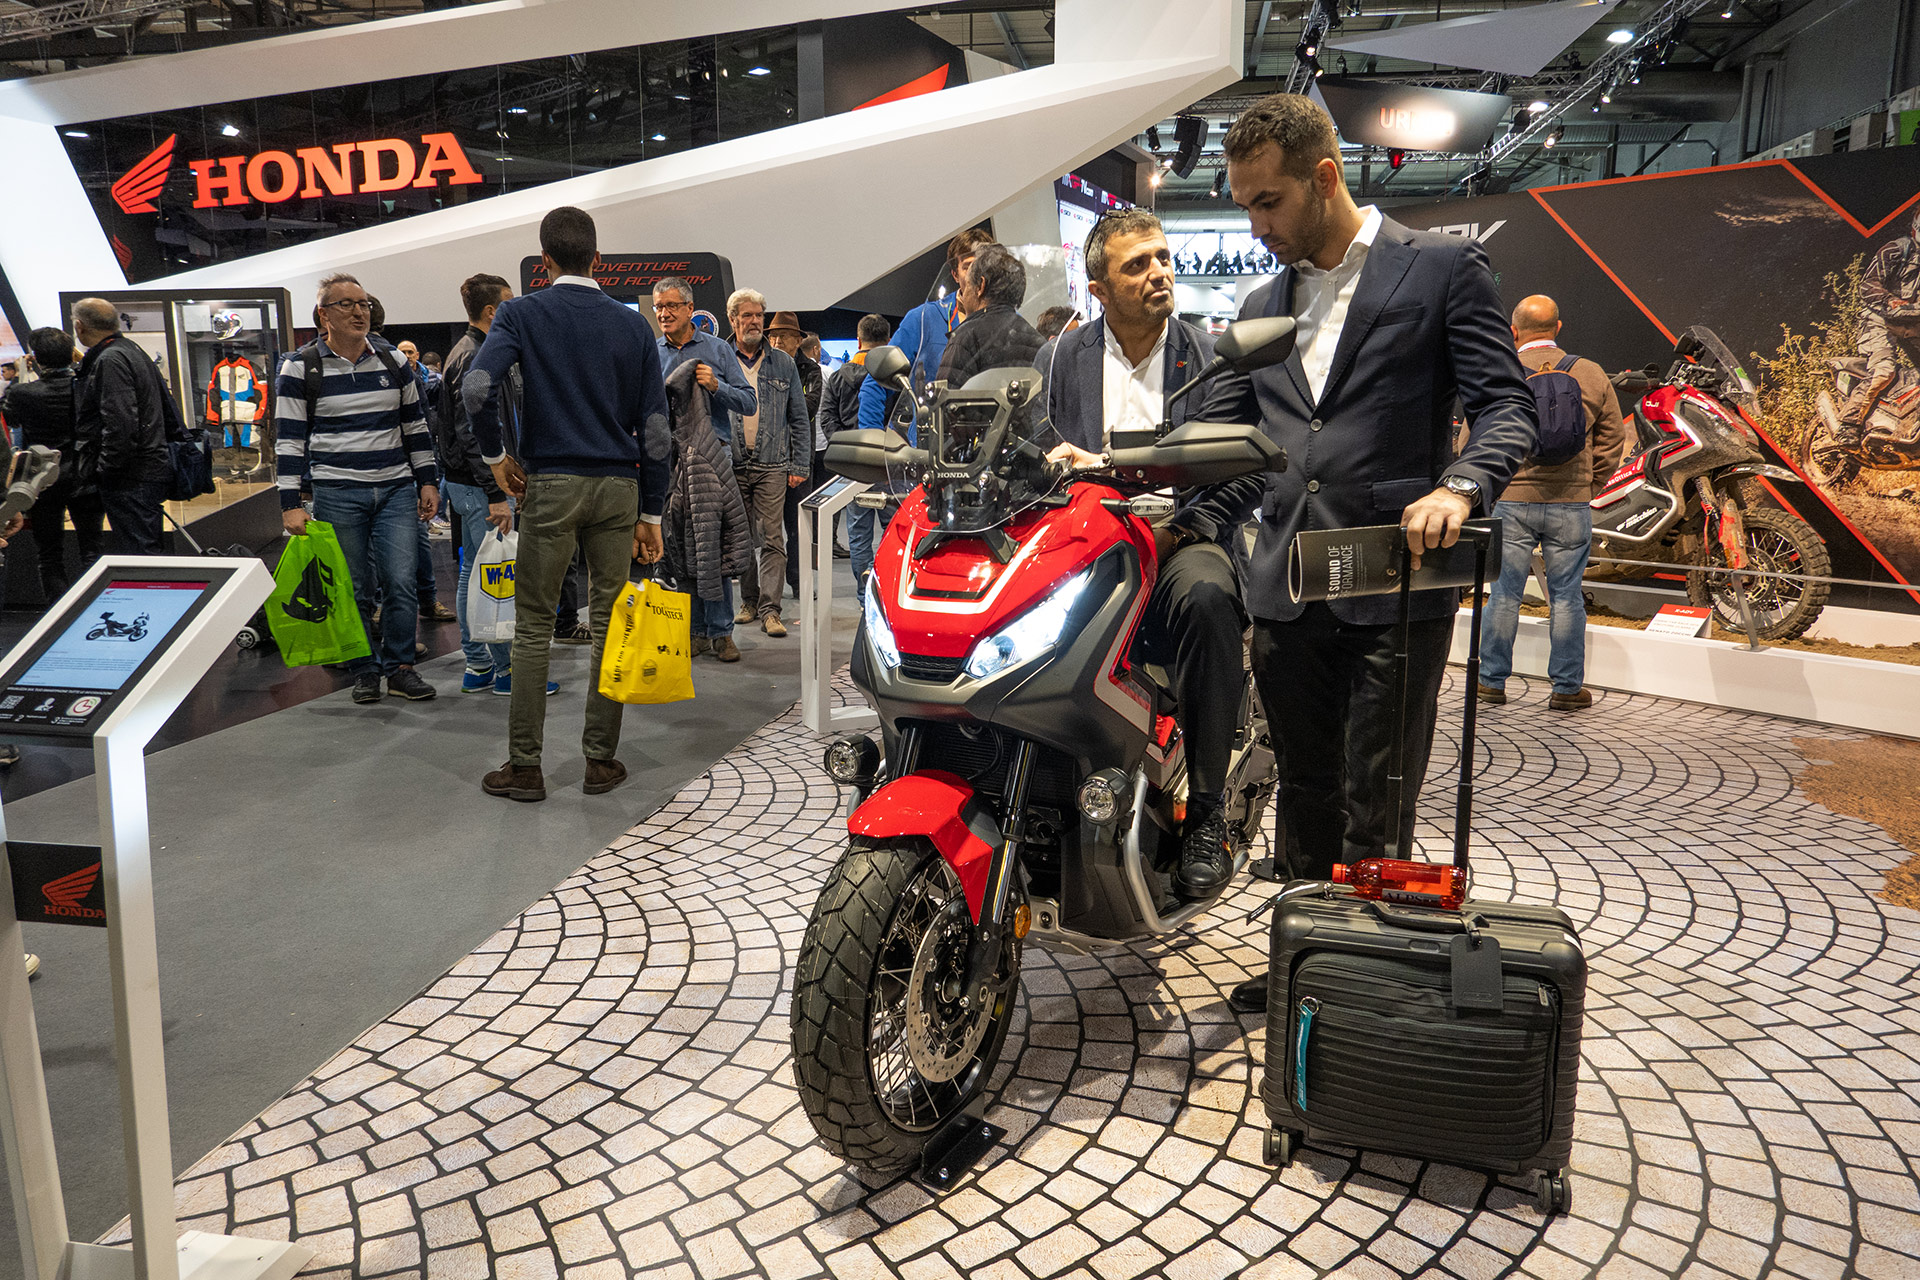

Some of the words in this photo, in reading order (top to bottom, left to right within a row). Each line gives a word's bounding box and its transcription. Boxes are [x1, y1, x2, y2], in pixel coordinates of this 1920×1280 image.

[189, 132, 483, 209] HONDA
[593, 261, 691, 272] DVENTURE
[623, 275, 712, 286] ACAMY
[1328, 545, 1340, 557] OF
[1329, 560, 1340, 592] SOUND
[44, 905, 107, 919] HONDA
